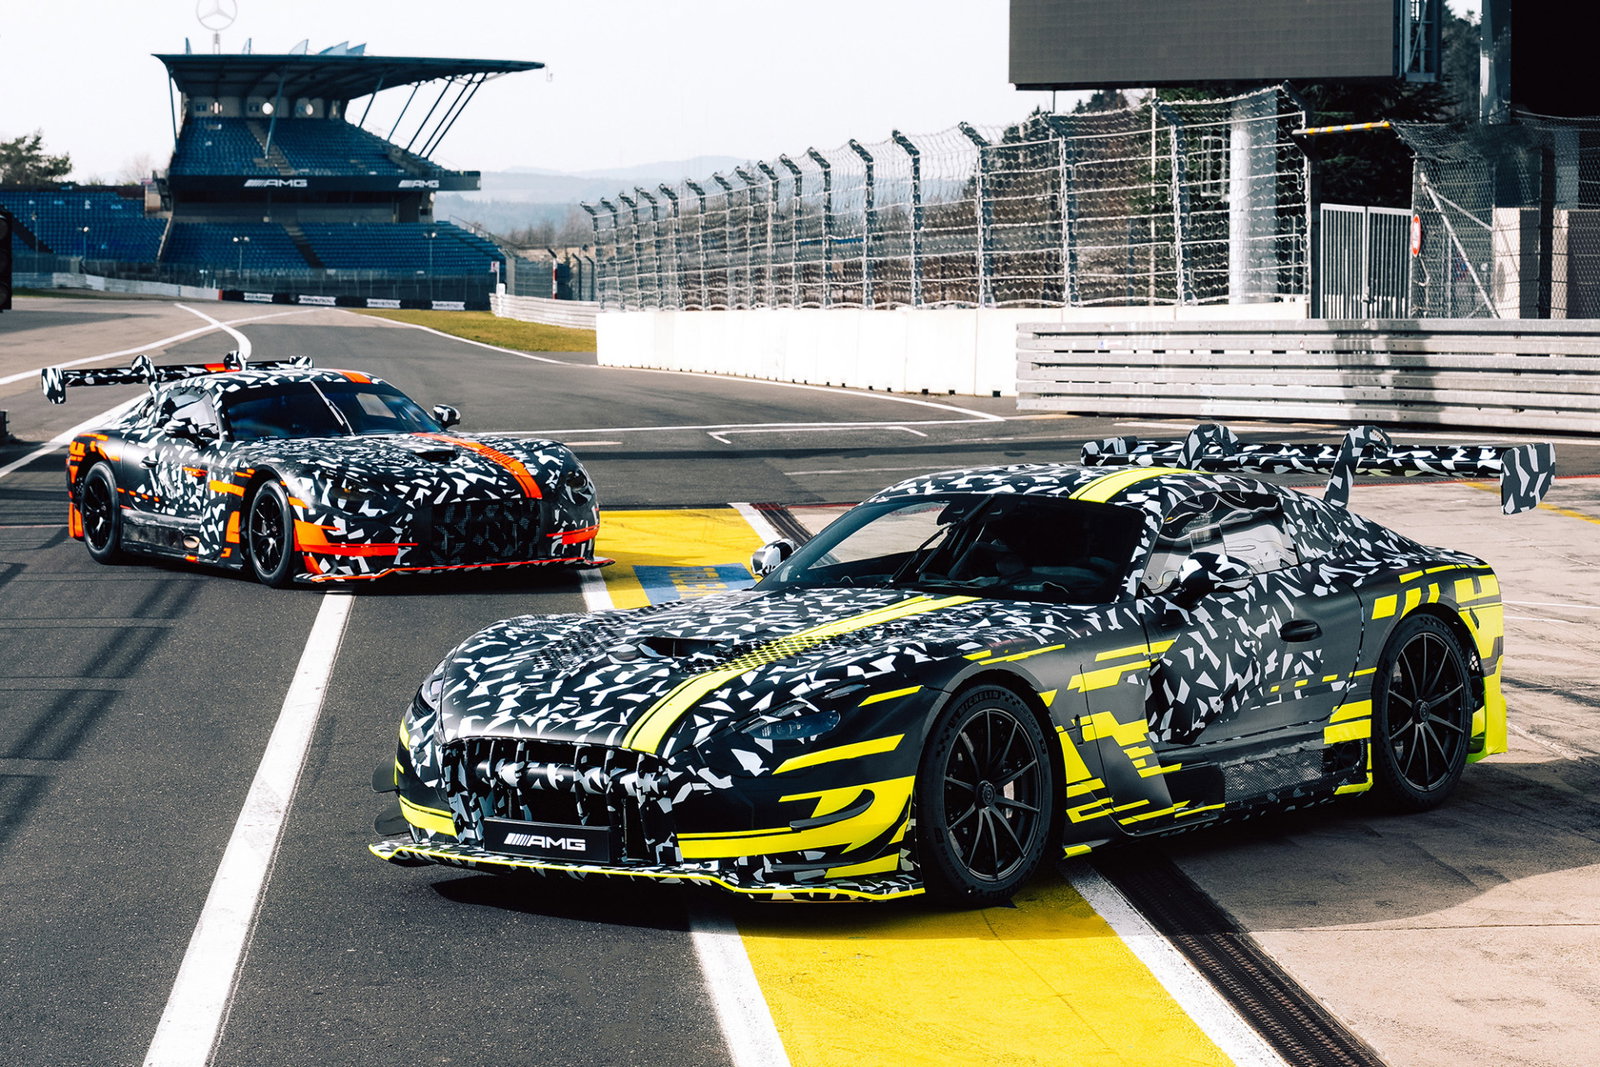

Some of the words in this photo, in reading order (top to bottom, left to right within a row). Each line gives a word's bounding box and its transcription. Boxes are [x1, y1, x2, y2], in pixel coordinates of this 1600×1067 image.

[264, 179, 307, 187] AMG
[412, 180, 439, 188] AMG
[957, 691, 999, 715] MICHELIN
[526, 835, 586, 851] AMG
